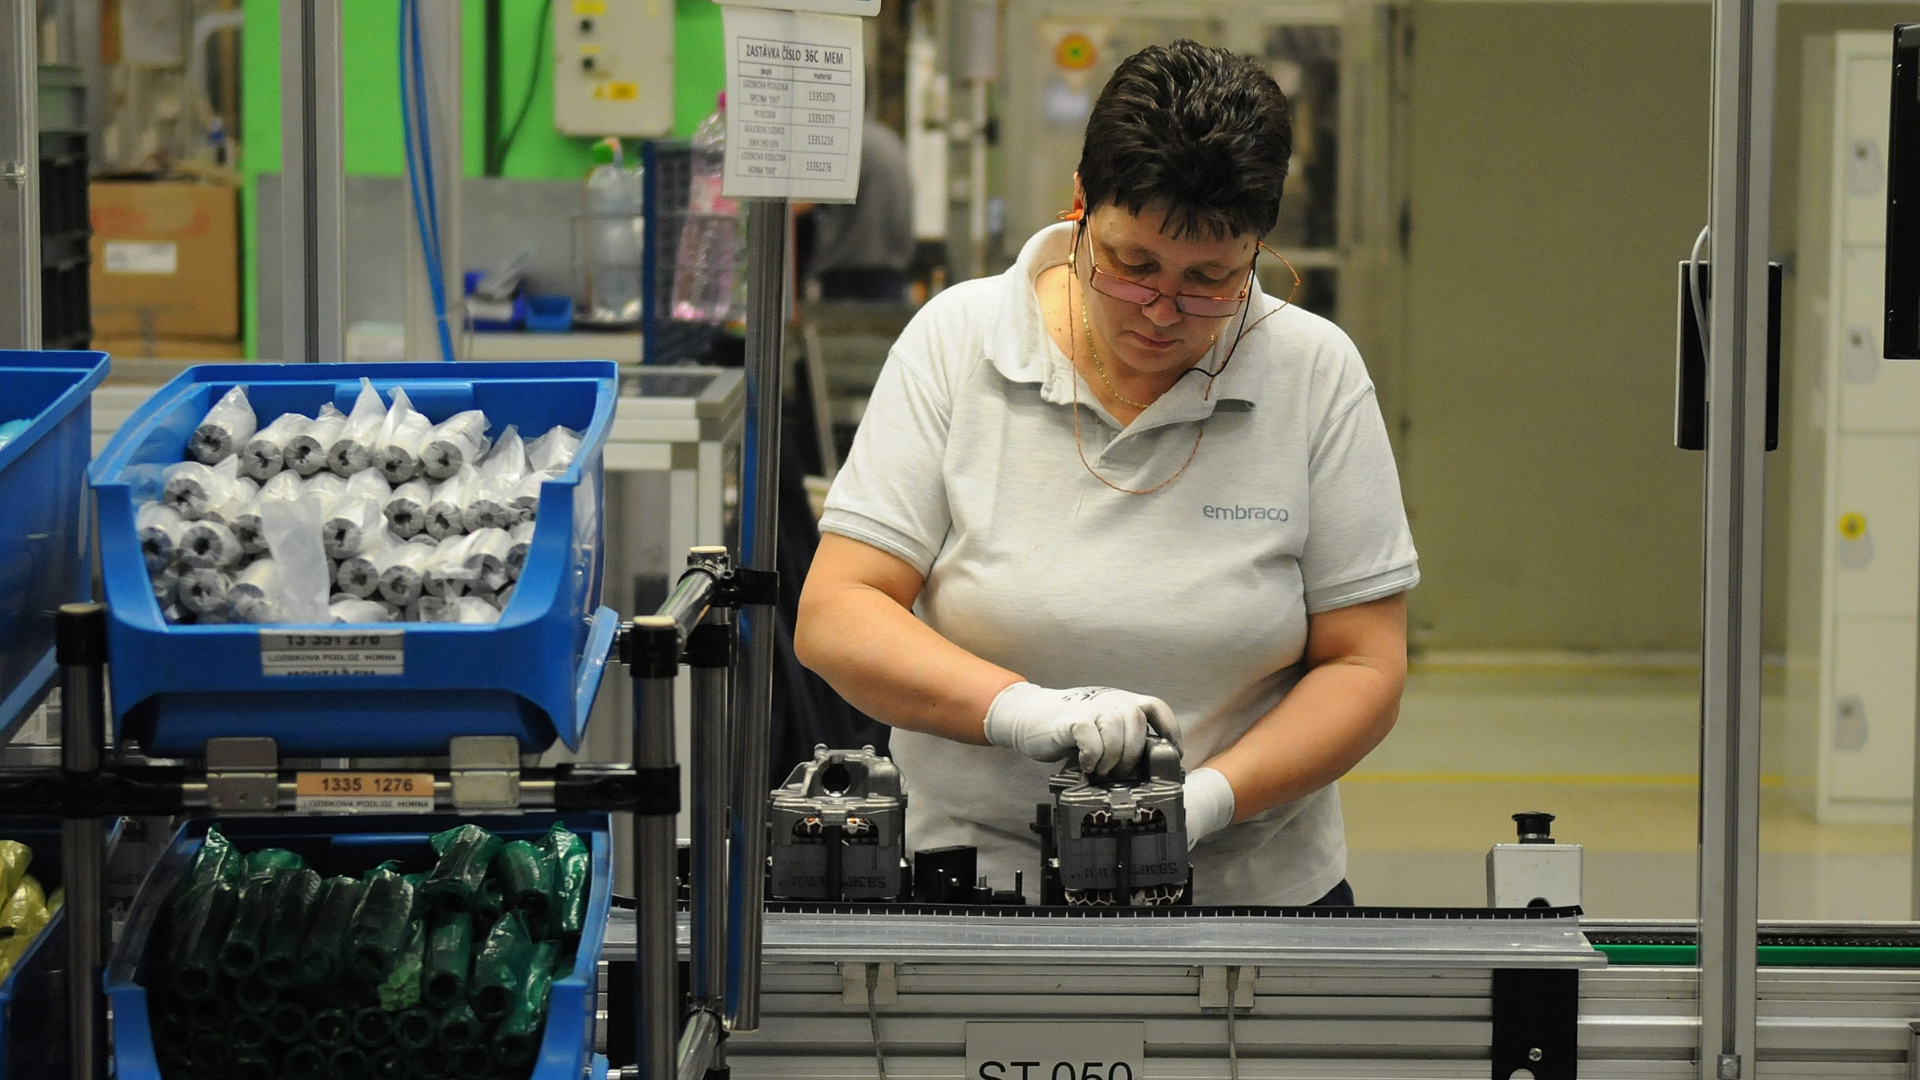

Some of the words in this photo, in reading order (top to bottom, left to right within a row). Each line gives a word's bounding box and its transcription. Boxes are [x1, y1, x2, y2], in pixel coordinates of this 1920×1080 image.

[746, 43, 780, 59] ZASTÁVKA
[782, 45, 801, 61] ČÍSLO
[805, 49, 819, 63] 36C
[824, 51, 843, 65] MEM
[808, 113, 835, 124] 13351079
[806, 161, 832, 172] 13351276
[1202, 504, 1289, 522] embraco
[322, 777, 362, 792] 1335
[373, 777, 413, 792] 1276
